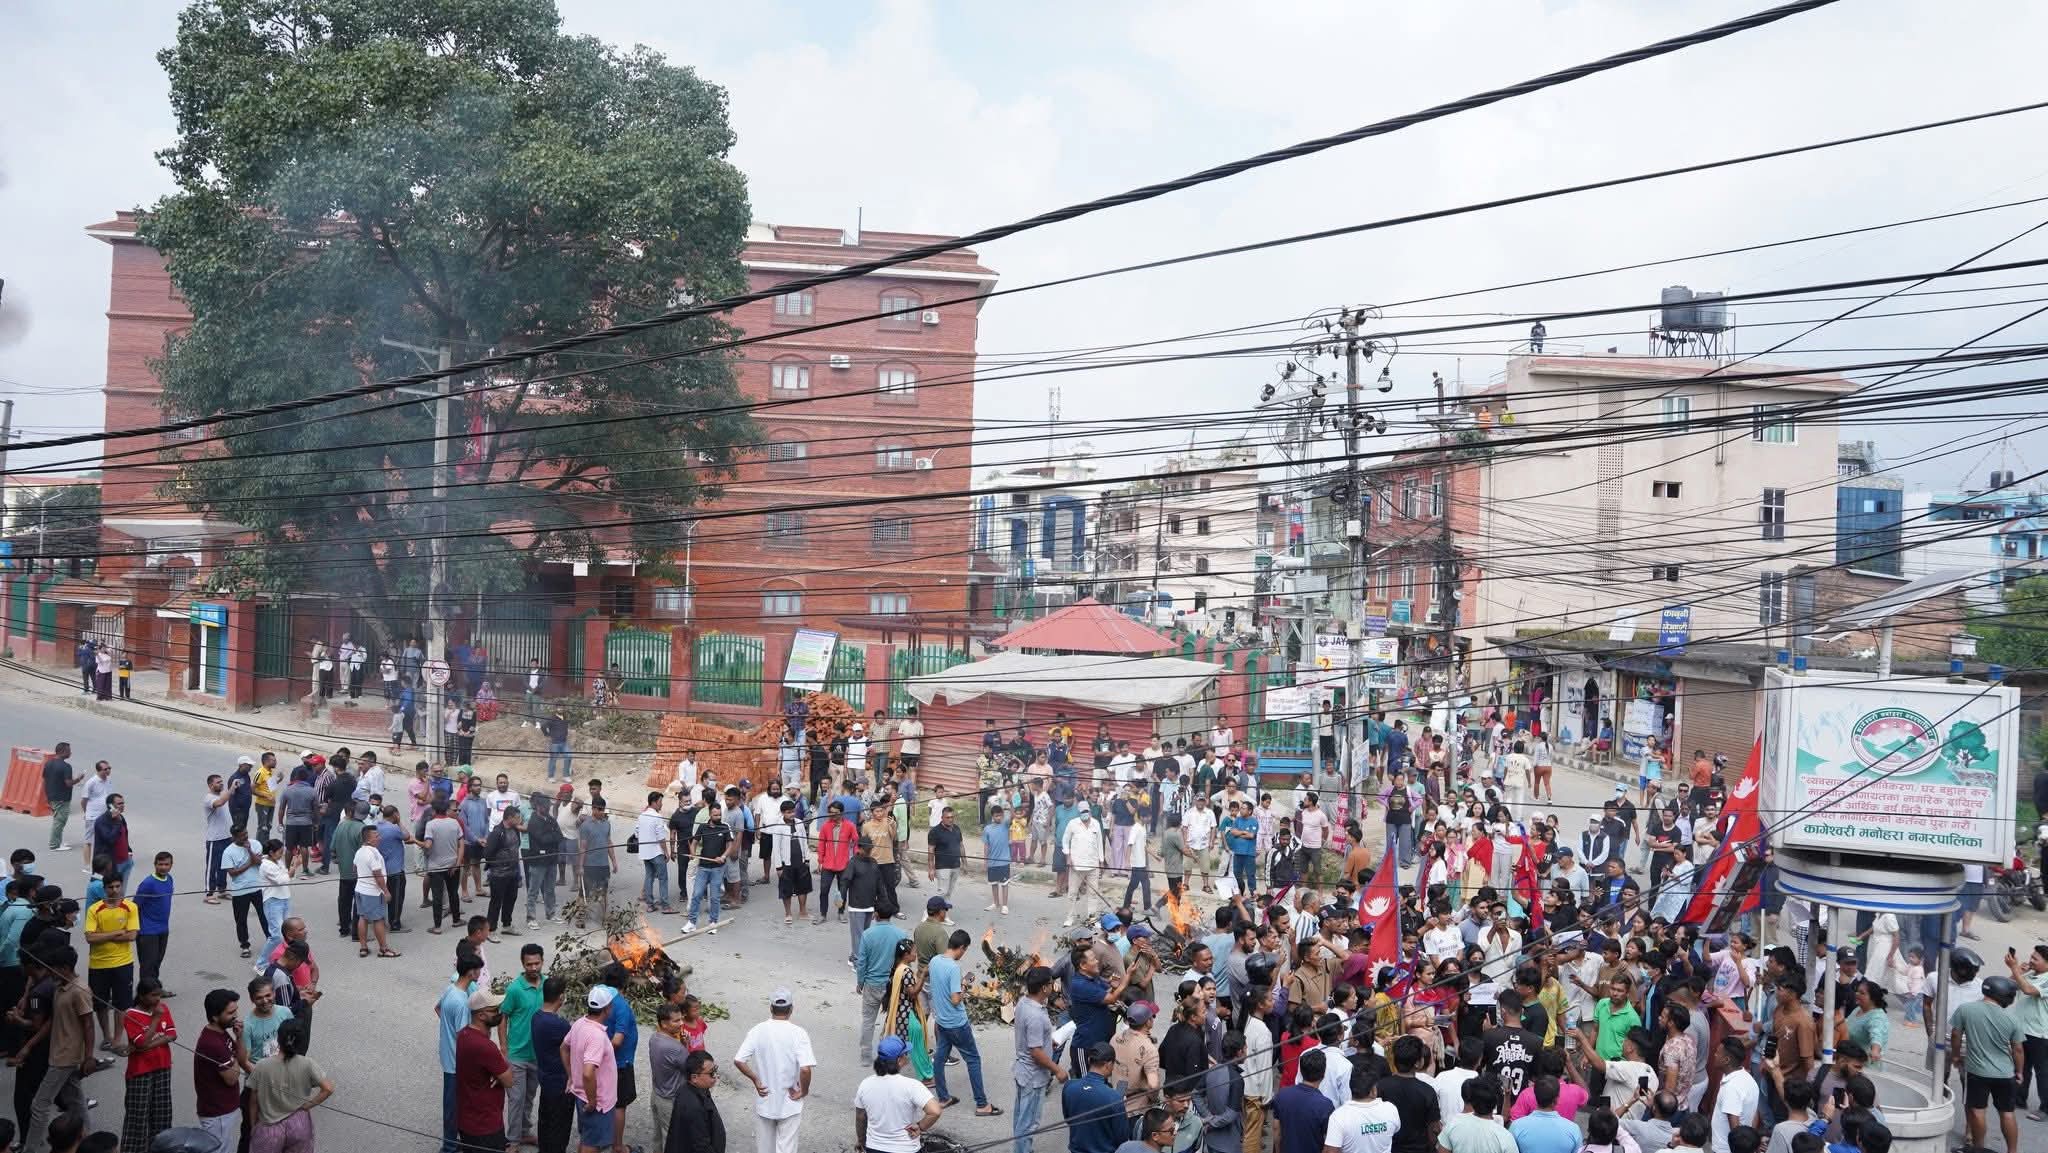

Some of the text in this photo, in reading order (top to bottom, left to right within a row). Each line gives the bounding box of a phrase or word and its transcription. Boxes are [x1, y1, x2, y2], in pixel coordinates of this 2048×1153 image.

[1803, 823, 1983, 848] कागेश्वरी मनोहरा नगरपालिका
[1361, 1122, 1387, 1135] LOSERS
